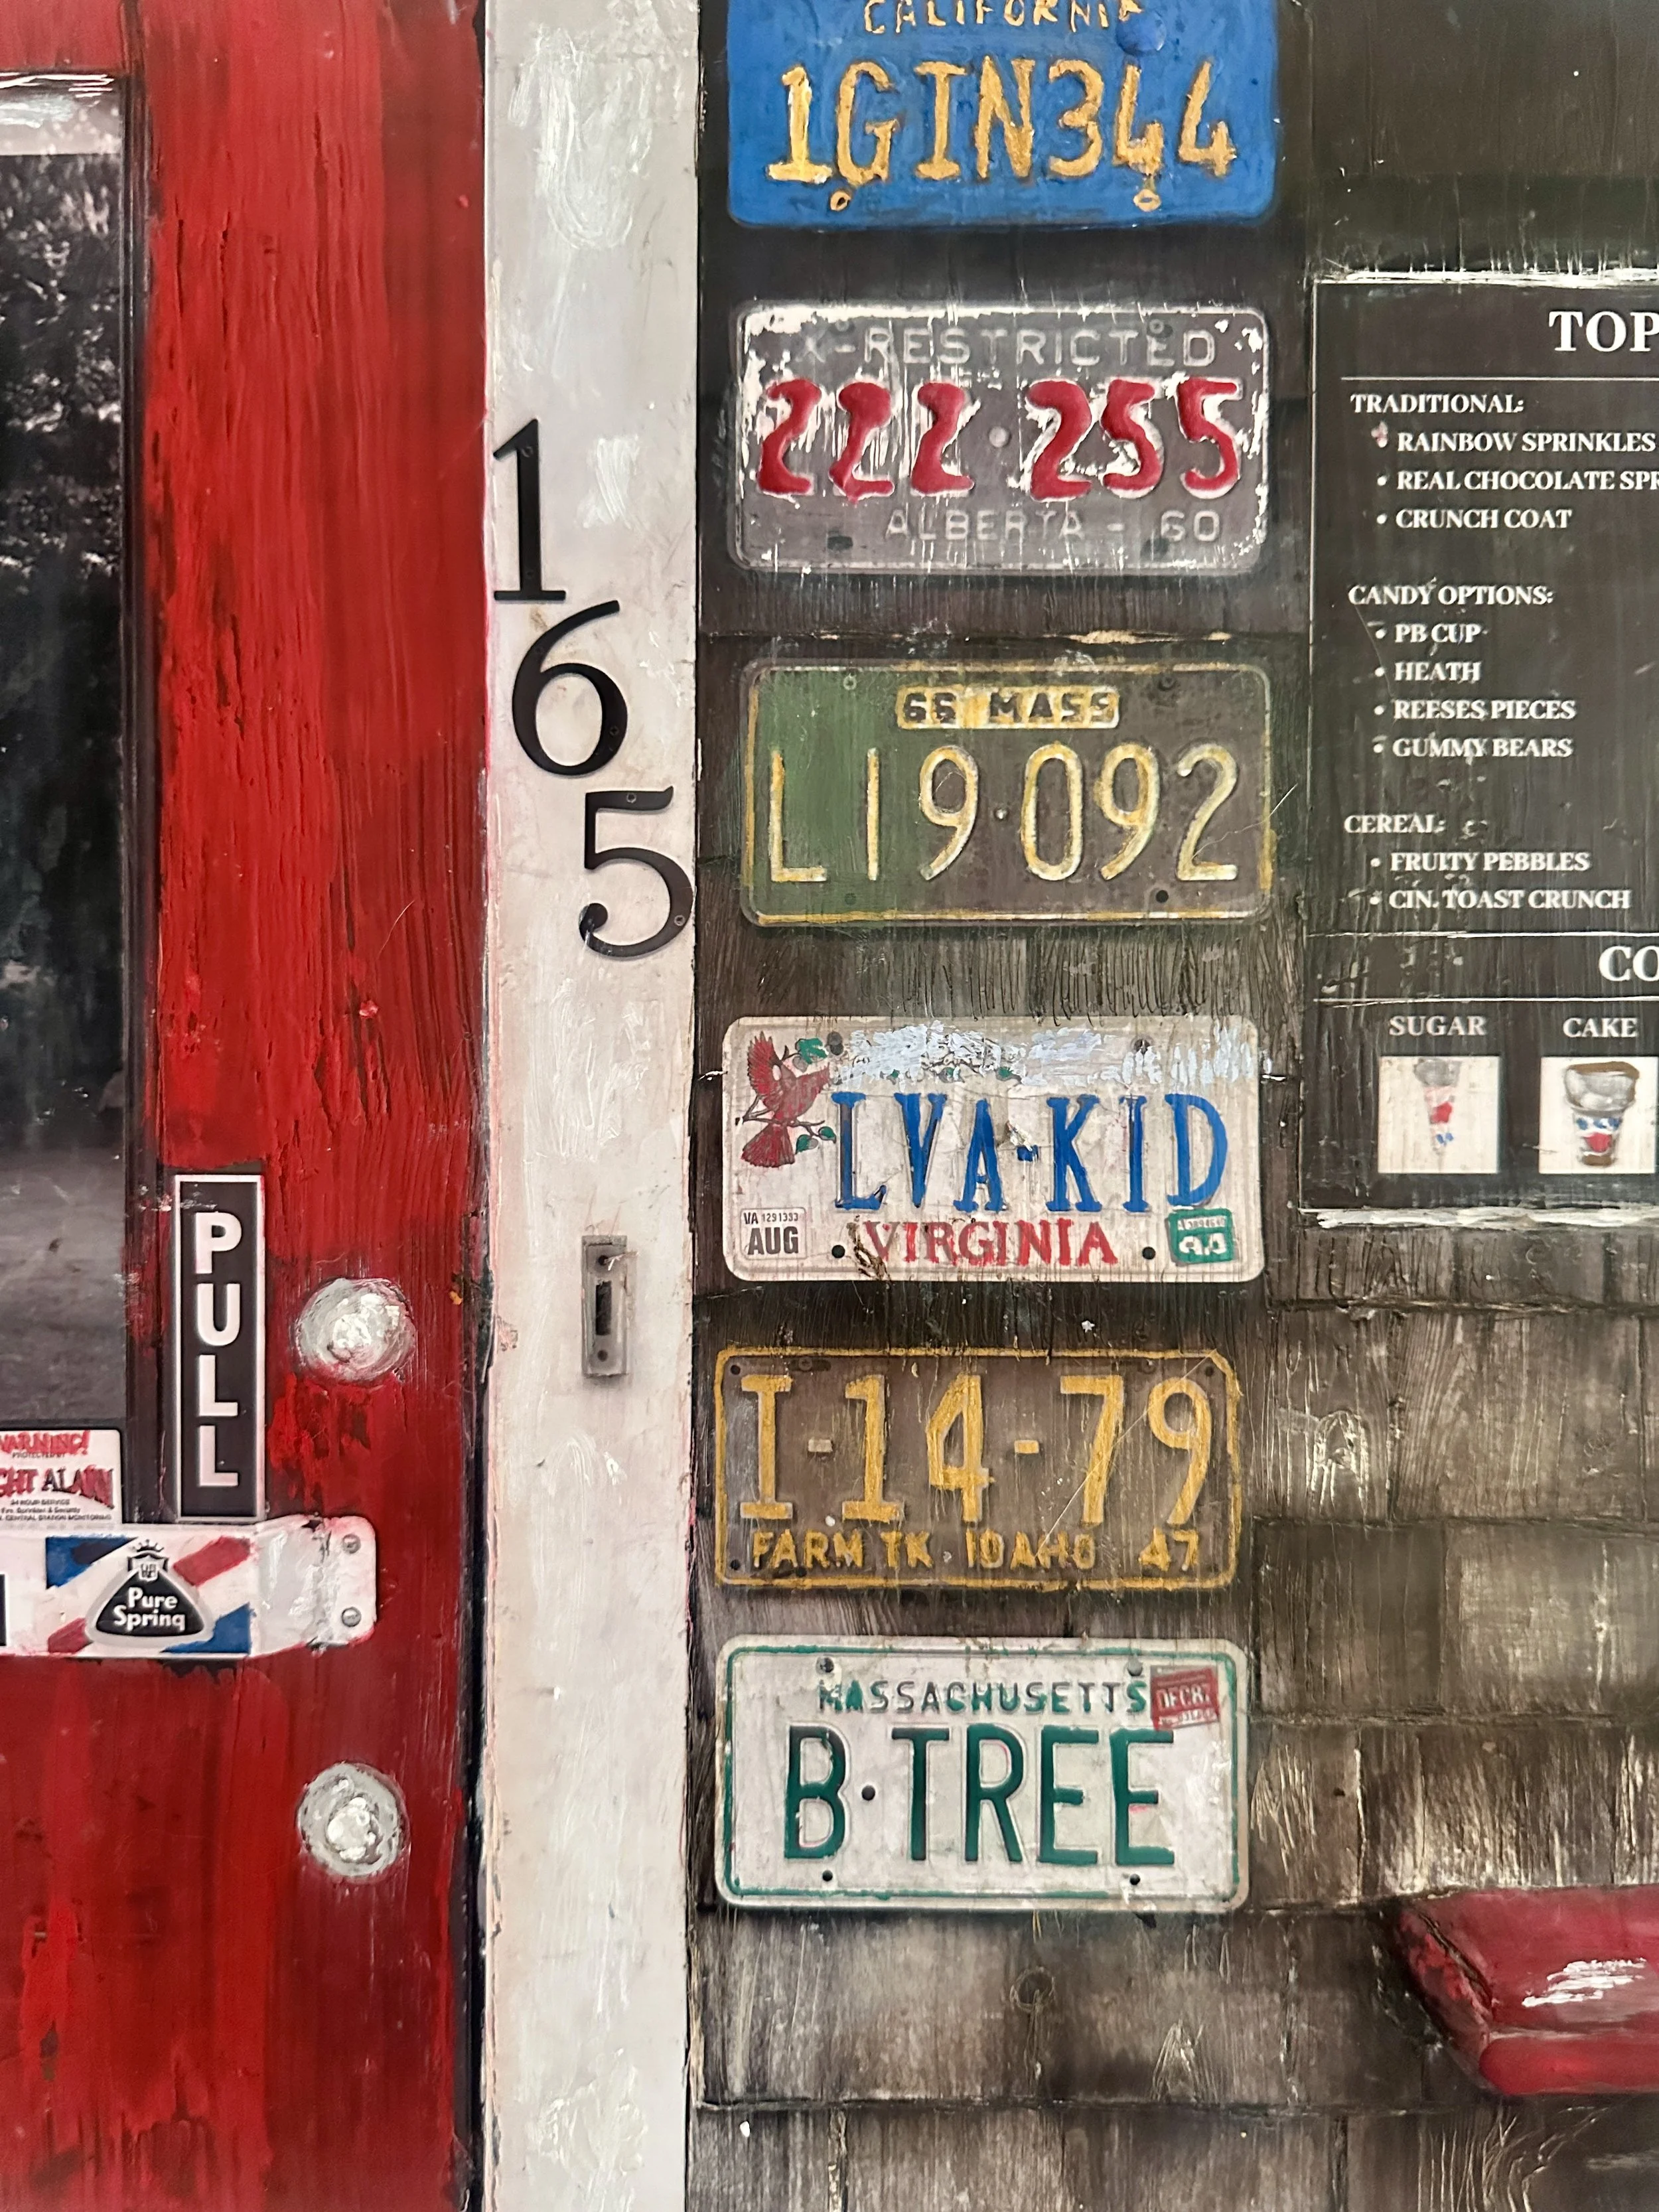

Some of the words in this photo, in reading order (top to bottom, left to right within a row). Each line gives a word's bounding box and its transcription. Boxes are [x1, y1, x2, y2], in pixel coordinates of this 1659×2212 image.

[766, 56, 1238, 185] 1GIN344
[1549, 311, 1659, 352] TOP
[1350, 394, 1524, 413] TRADITIONAL:
[1398, 431, 1516, 452] RAINBOW
[1522, 432, 1656, 452] SPRINKLES
[1397, 471, 1461, 490] REAL
[1465, 471, 1615, 490] CHOCOLATE
[1620, 471, 1659, 490] SP
[885, 510, 1085, 542] ALBERTA
[1396, 509, 1497, 528] CRUNCH
[1504, 509, 1572, 528] COAT
[1348, 585, 1433, 605] CANDY
[1438, 585, 1553, 605] OPTIONS:
[1394, 624, 1426, 642] PB
[1431, 623, 1482, 642] CUP
[1394, 662, 1481, 680] HEATH
[989, 692, 1116, 723] MASS
[1394, 700, 1486, 719] REESES
[1491, 700, 1577, 719] PIECES
[1392, 738, 1488, 757] GUMMY
[1492, 739, 1573, 757] BEARS
[1344, 815, 1445, 833] CEREAL:
[1390, 852, 1479, 871] FRUITY
[1483, 852, 1591, 871] PEBBLES
[1389, 890, 1439, 909] CIN.
[1442, 890, 1524, 909] TOAST
[1528, 890, 1632, 909] CRUNCH
[1389, 1015, 1486, 1036] SUGAR
[1563, 1017, 1638, 1037] CAKE
[744, 1213, 758, 1224] VA
[748, 1226, 799, 1255] AUG
[863, 1218, 1118, 1266] VIRGINIA
[195, 1213, 242, 1487] PULL
[753, 1528, 864, 1569] FARM
[880, 1530, 932, 1569] TK
[966, 1528, 1094, 1569] IDAHO
[1139, 1528, 1200, 1571] 47
[128, 1587, 178, 1609] Pure
[113, 1605, 185, 1631] Spring
[819, 1680, 1147, 1714] MASSACHUSETTS
